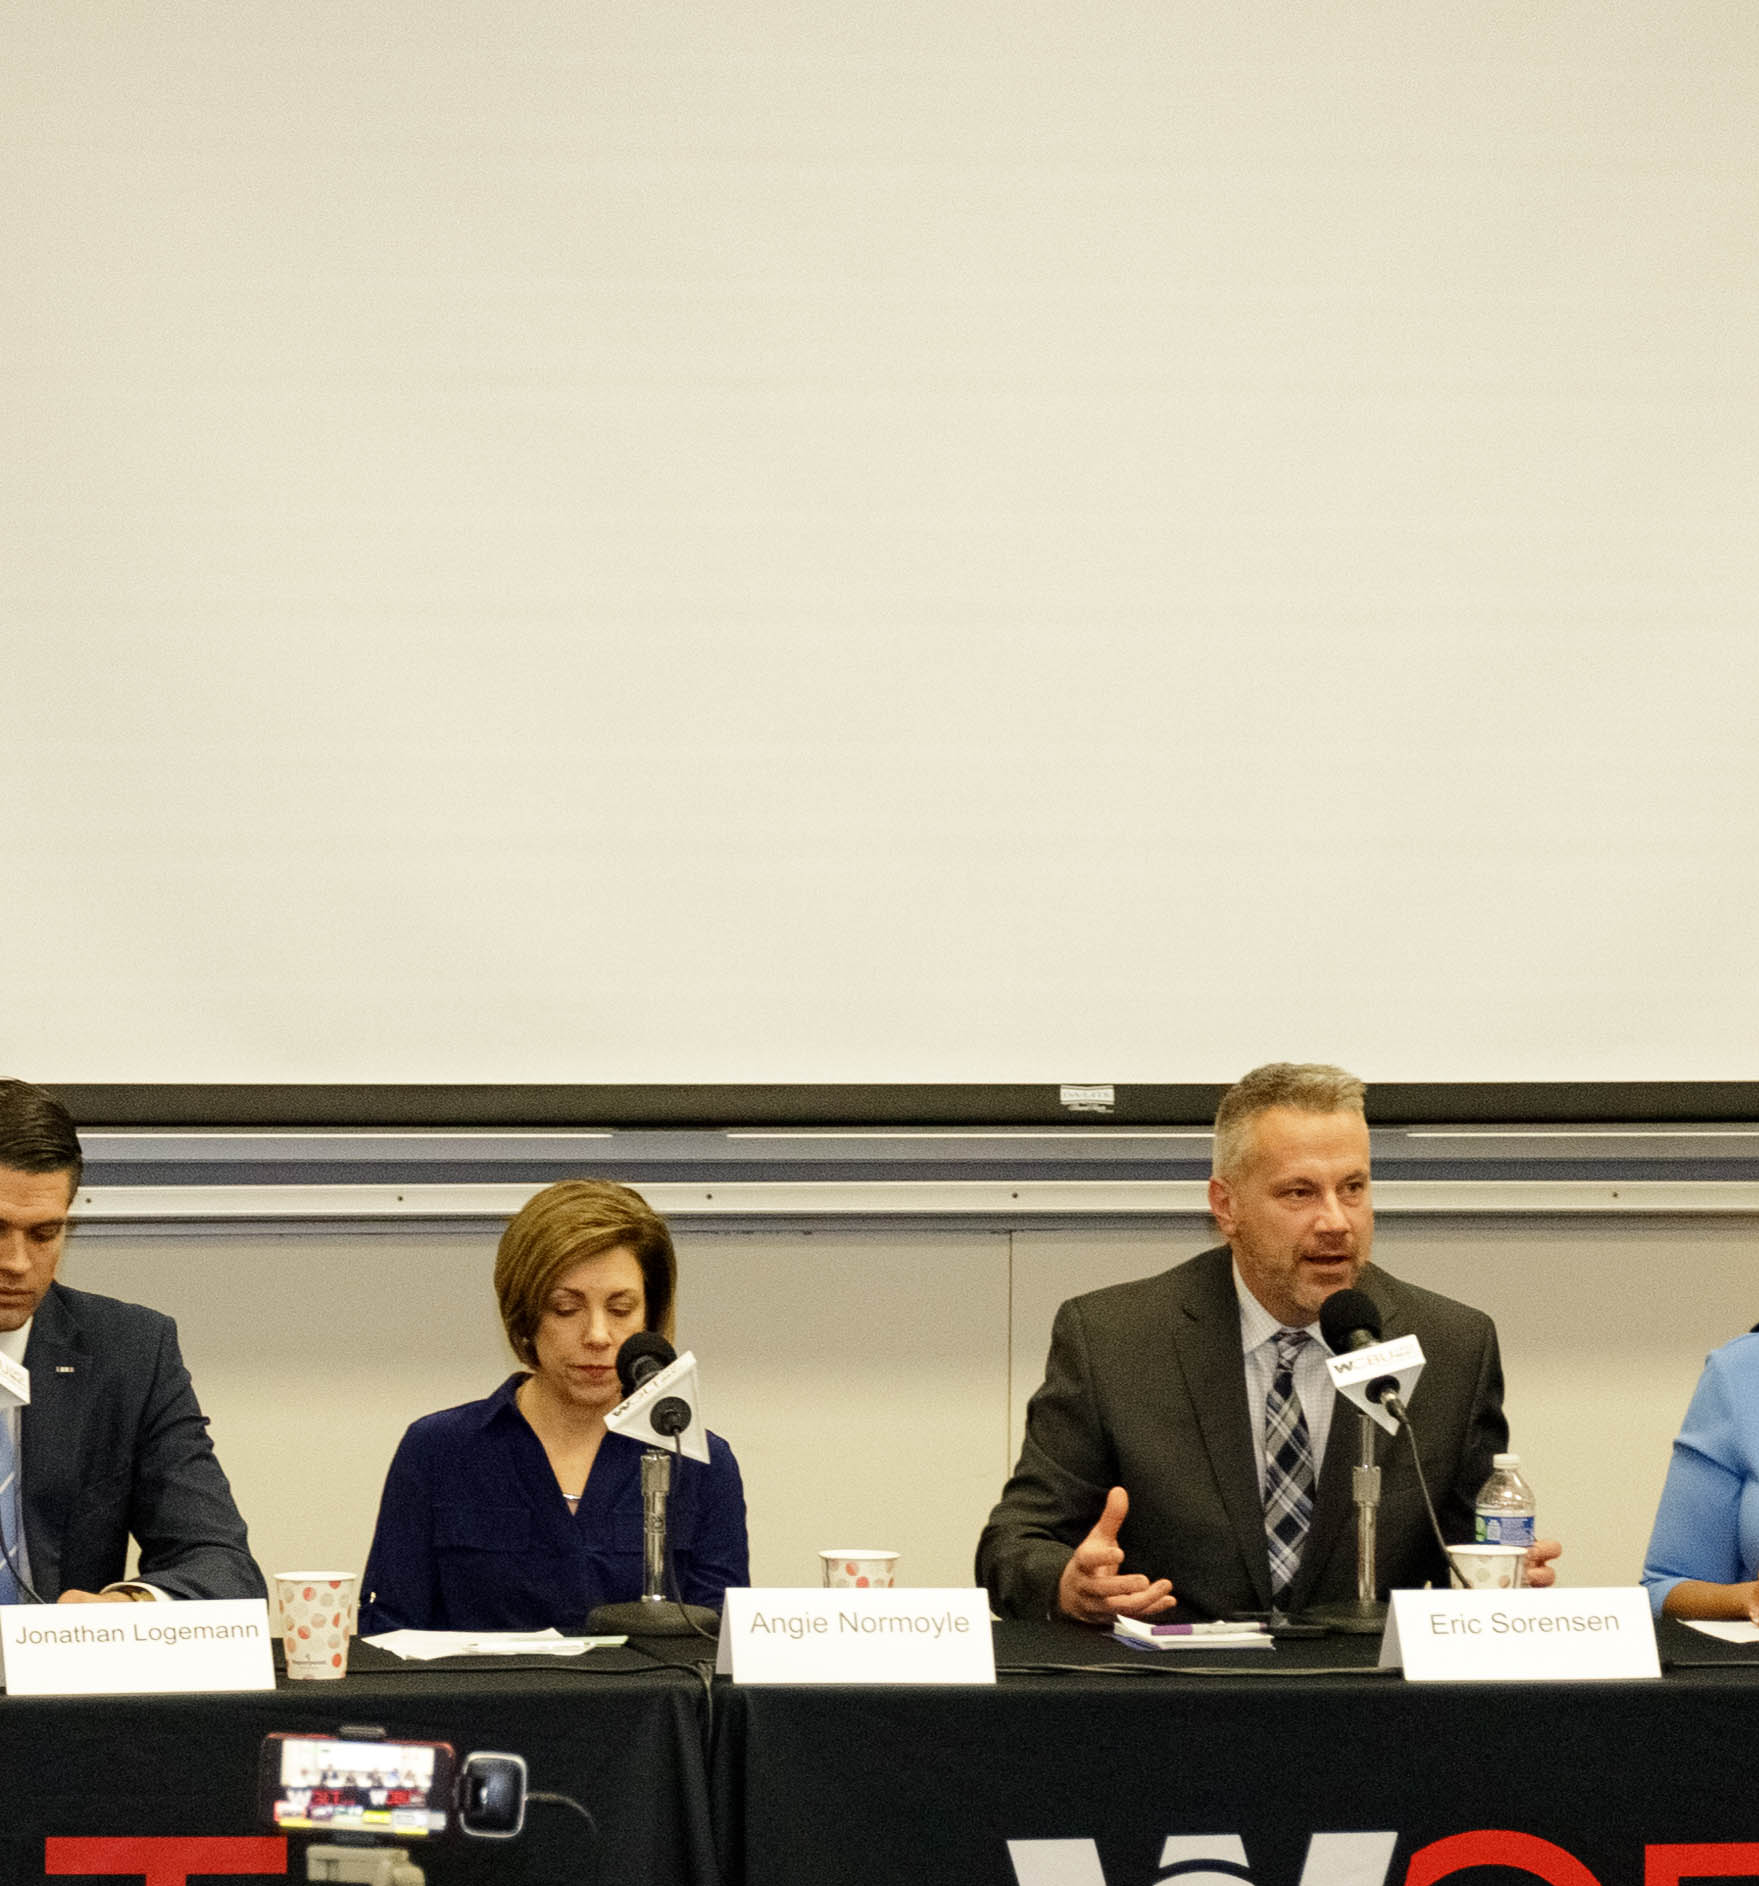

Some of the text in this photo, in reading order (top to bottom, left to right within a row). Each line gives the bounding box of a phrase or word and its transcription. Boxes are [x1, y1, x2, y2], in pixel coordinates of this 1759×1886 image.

[15, 1623, 260, 1646] Jonathan Logemann
[750, 1611, 970, 1640] Angie Normoyle
[1430, 1611, 1620, 1635] Eric Sorensen
